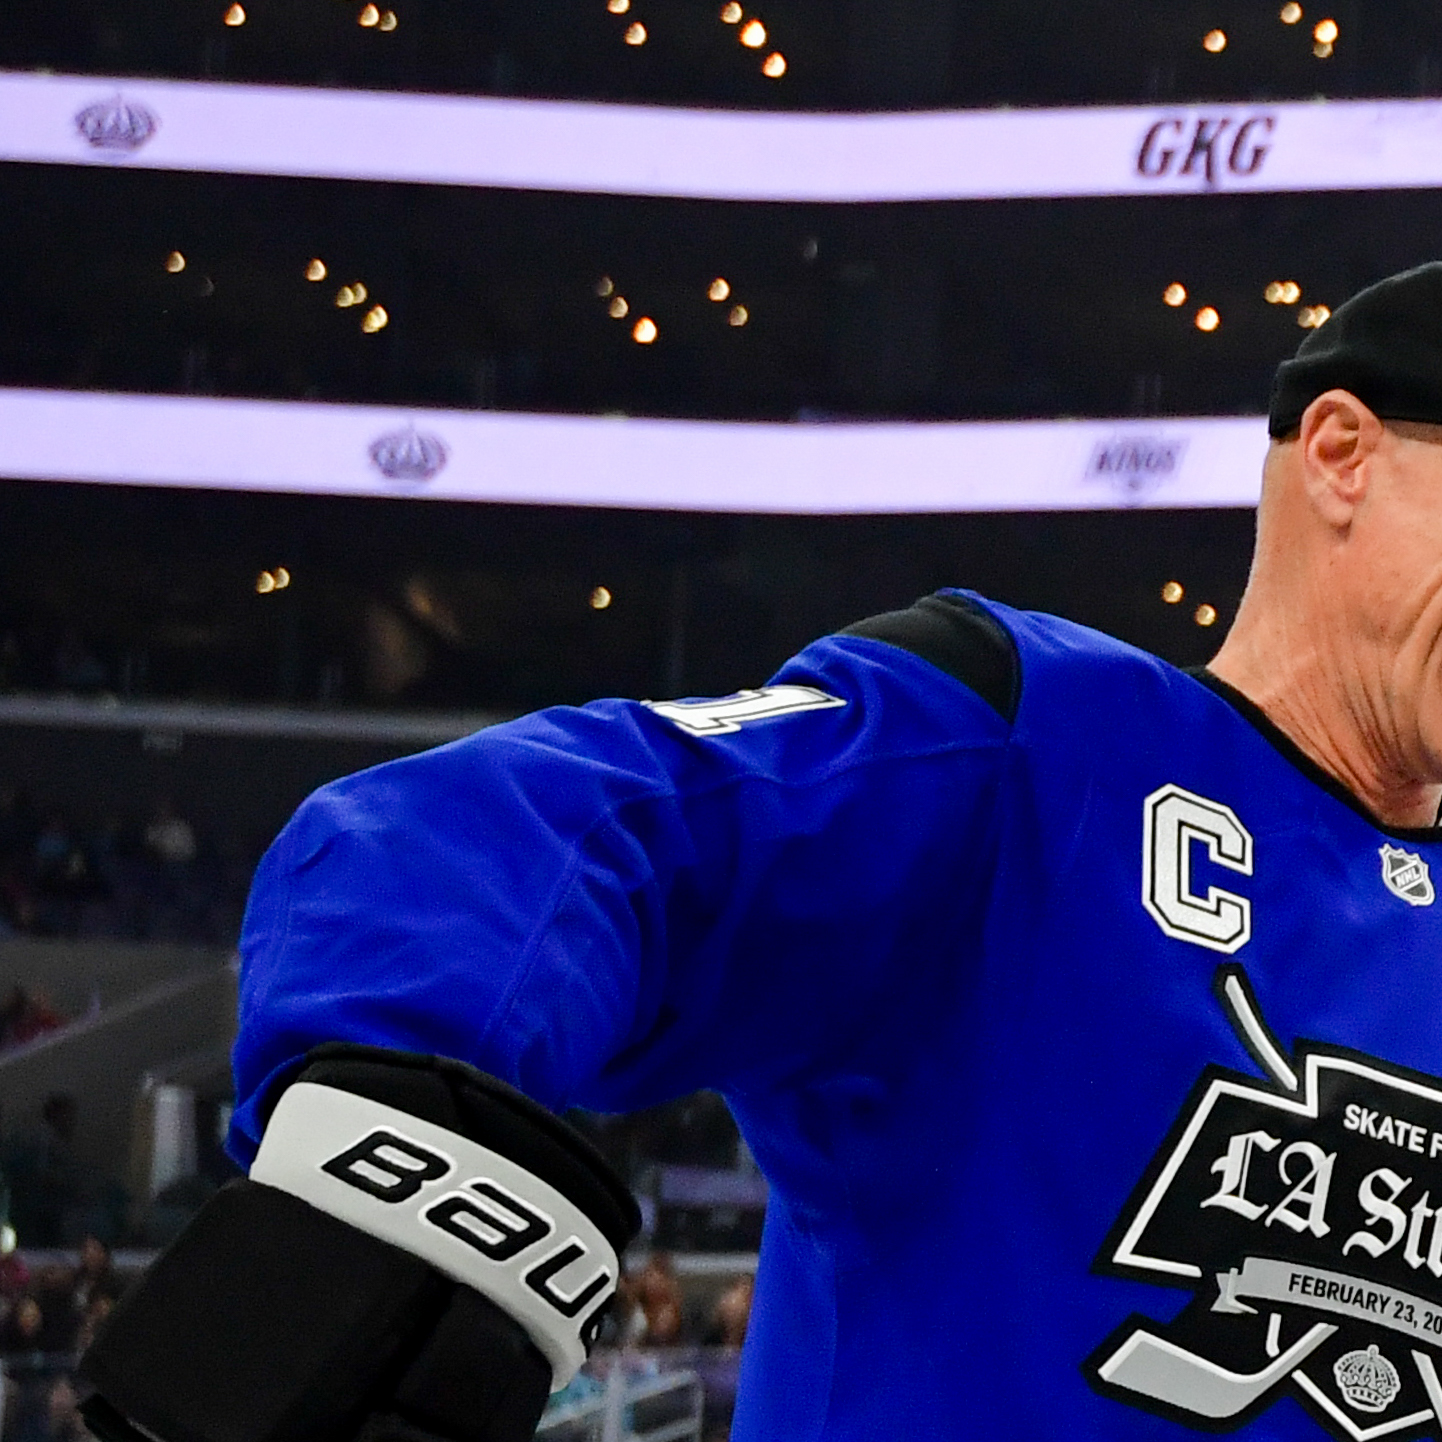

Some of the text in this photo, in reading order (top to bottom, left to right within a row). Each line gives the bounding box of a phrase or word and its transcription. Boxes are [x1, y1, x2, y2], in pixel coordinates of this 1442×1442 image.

[1136, 117, 1276, 183] GKG
[1142, 783, 1253, 954] C
[1343, 1103, 1428, 1155] SKATE
[1200, 1130, 1338, 1239] LA
[1288, 1272, 1392, 1315] FEBRUARY
[1393, 1300, 1419, 1330] 23,
